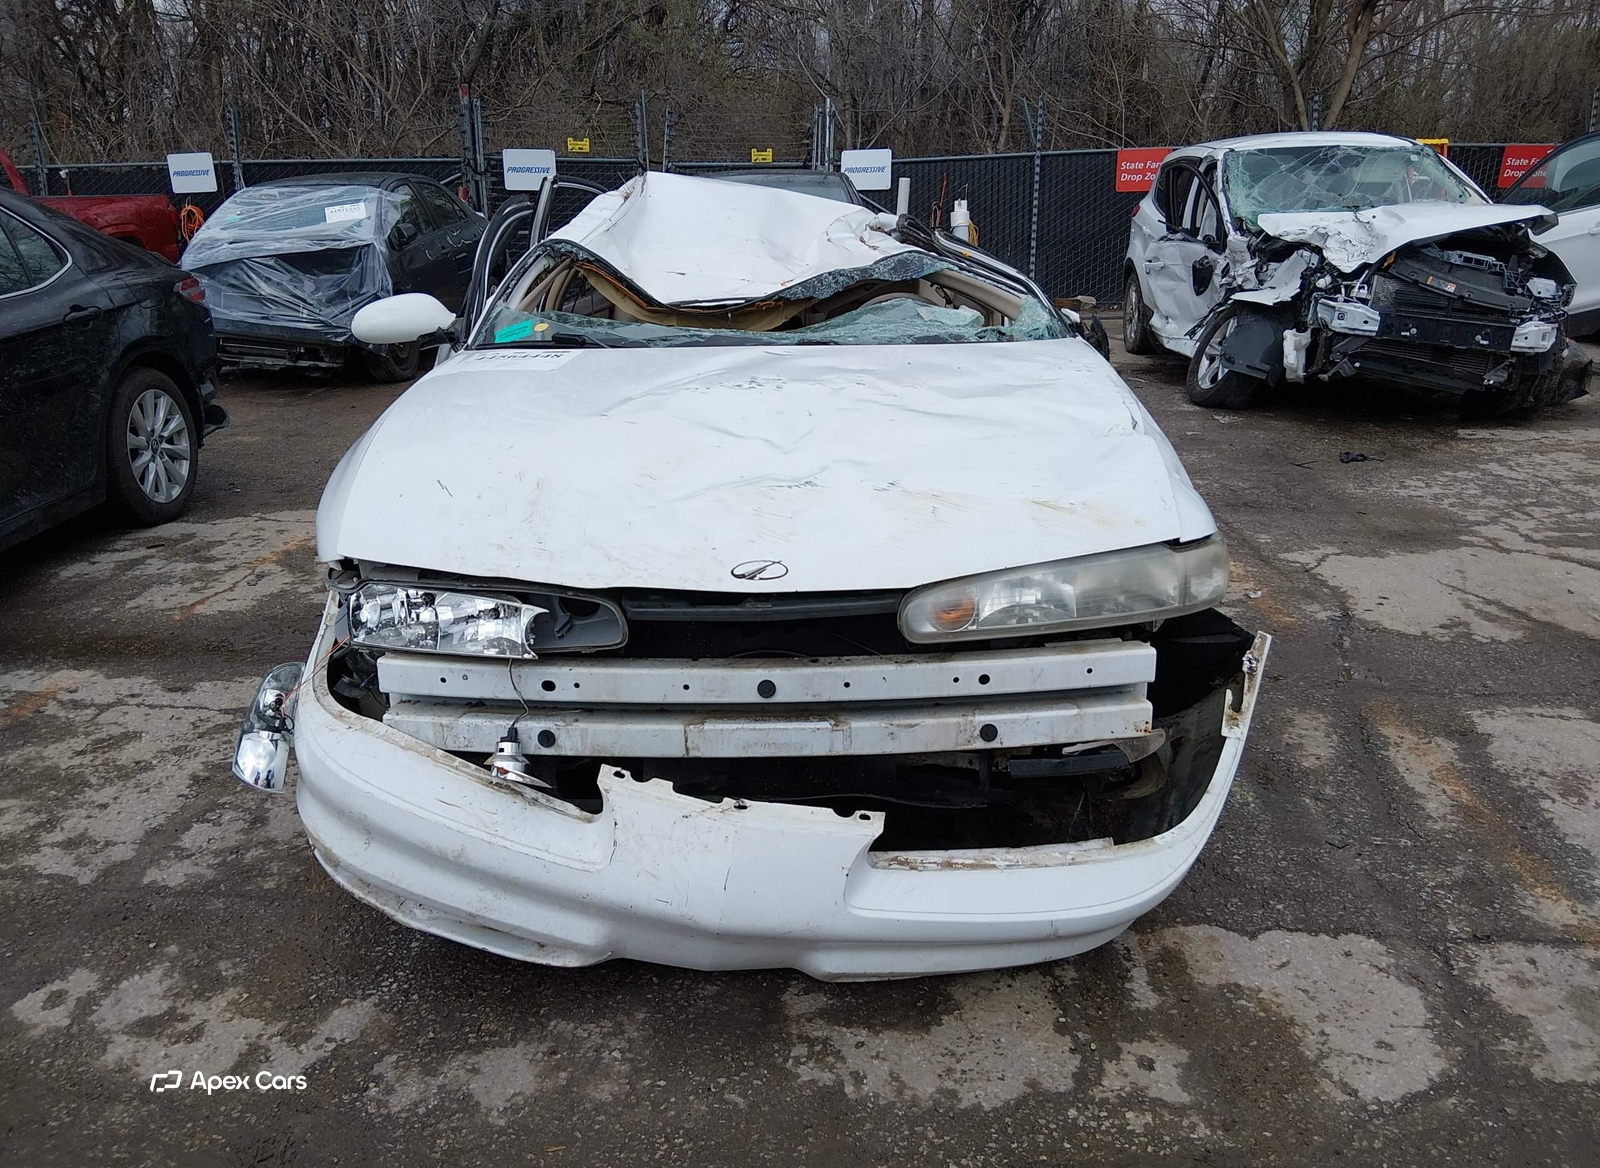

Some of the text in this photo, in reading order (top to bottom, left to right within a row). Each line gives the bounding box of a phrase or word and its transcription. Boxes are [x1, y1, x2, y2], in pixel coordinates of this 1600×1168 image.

[1120, 160, 1160, 170] State Far
[1505, 157, 1529, 166] State
[172, 169, 210, 177] PROGRESSIVE
[506, 166, 551, 174] PROGRESSIVE
[844, 165, 887, 174] PROGRESSIVE
[1503, 169, 1526, 178] Drop
[1120, 172, 1156, 183] Drop Zo
